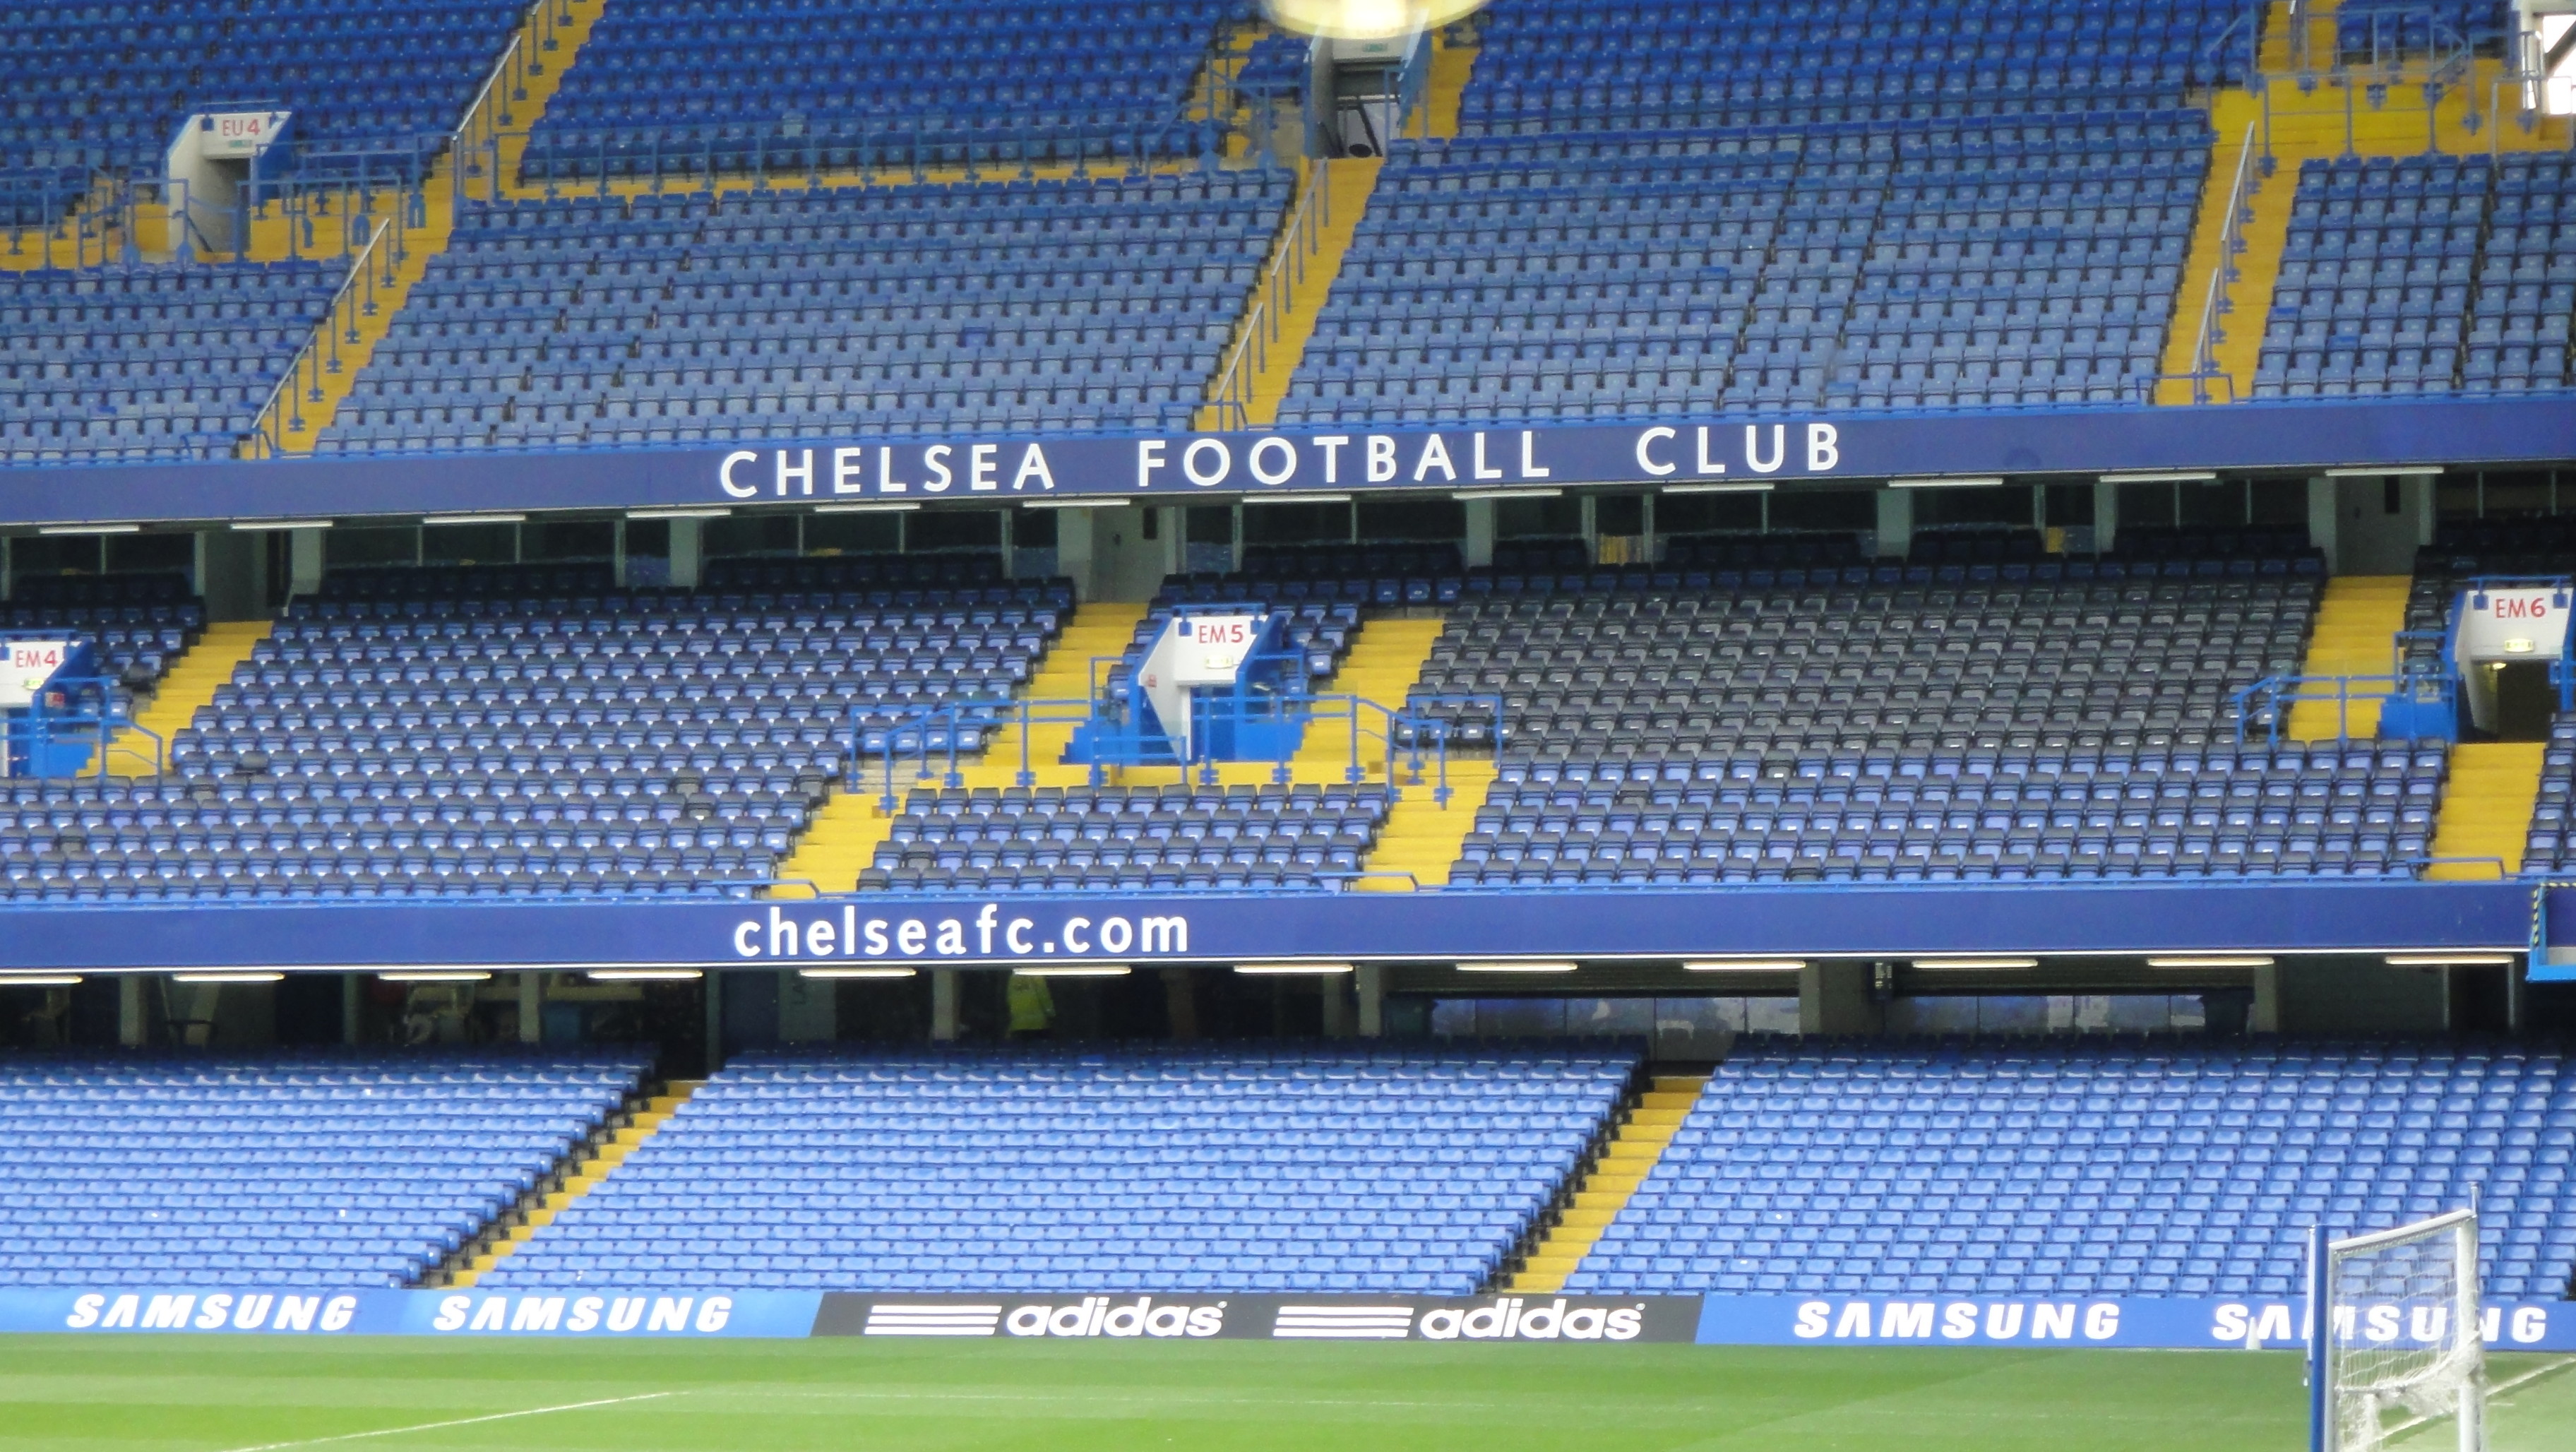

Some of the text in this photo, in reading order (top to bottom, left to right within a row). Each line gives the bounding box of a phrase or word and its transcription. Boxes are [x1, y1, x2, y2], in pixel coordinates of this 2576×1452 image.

[720, 423, 1839, 498] CHELSEA FOOTBALL CLUB
[734, 904, 1188, 957] chelseafc.com
[66, 1293, 357, 1332] SAMSUNG
[432, 1295, 733, 1333] SAMSUNG
[1006, 1297, 1224, 1337] adidas
[1420, 1298, 1642, 1340] adidas
[1794, 1299, 2121, 1341] SAMSUNG
